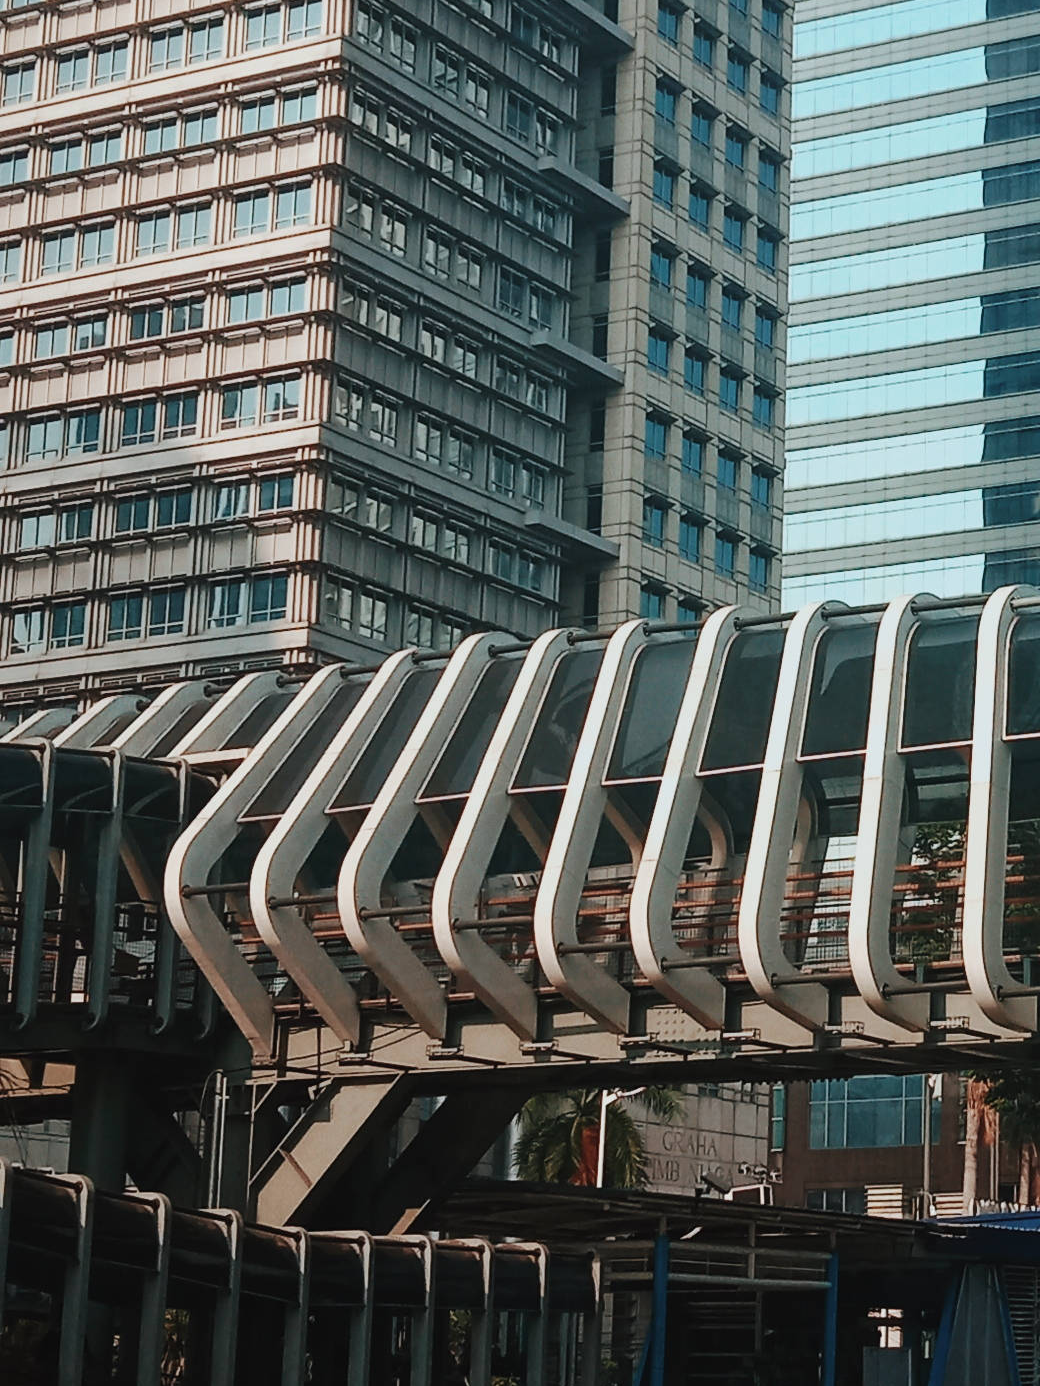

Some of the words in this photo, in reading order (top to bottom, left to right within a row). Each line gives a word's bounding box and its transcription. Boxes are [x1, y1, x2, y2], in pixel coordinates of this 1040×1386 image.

[662, 1130, 717, 1156] GRAHA
[649, 1157, 680, 1182] IMB
[688, 1162, 733, 1186] NIGA
